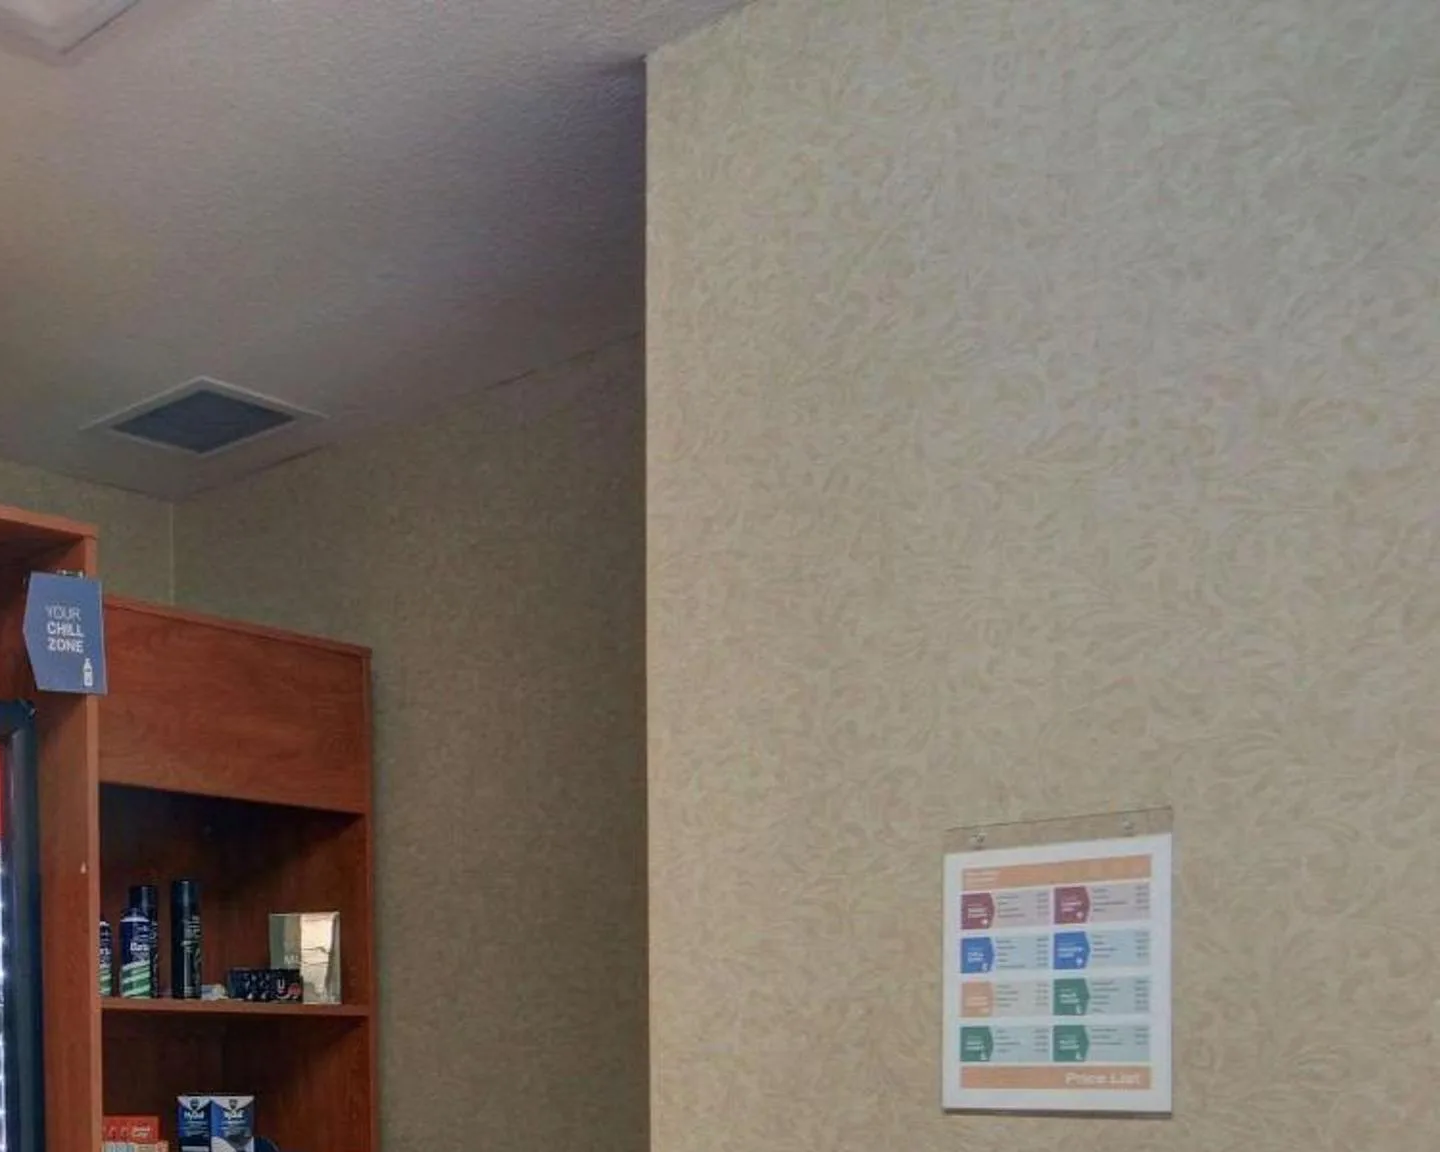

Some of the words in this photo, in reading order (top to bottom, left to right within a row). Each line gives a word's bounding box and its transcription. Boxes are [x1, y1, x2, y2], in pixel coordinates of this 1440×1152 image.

[46, 605, 82, 621] YOUR
[47, 621, 85, 638] CHILL
[48, 637, 84, 653] ZONE
